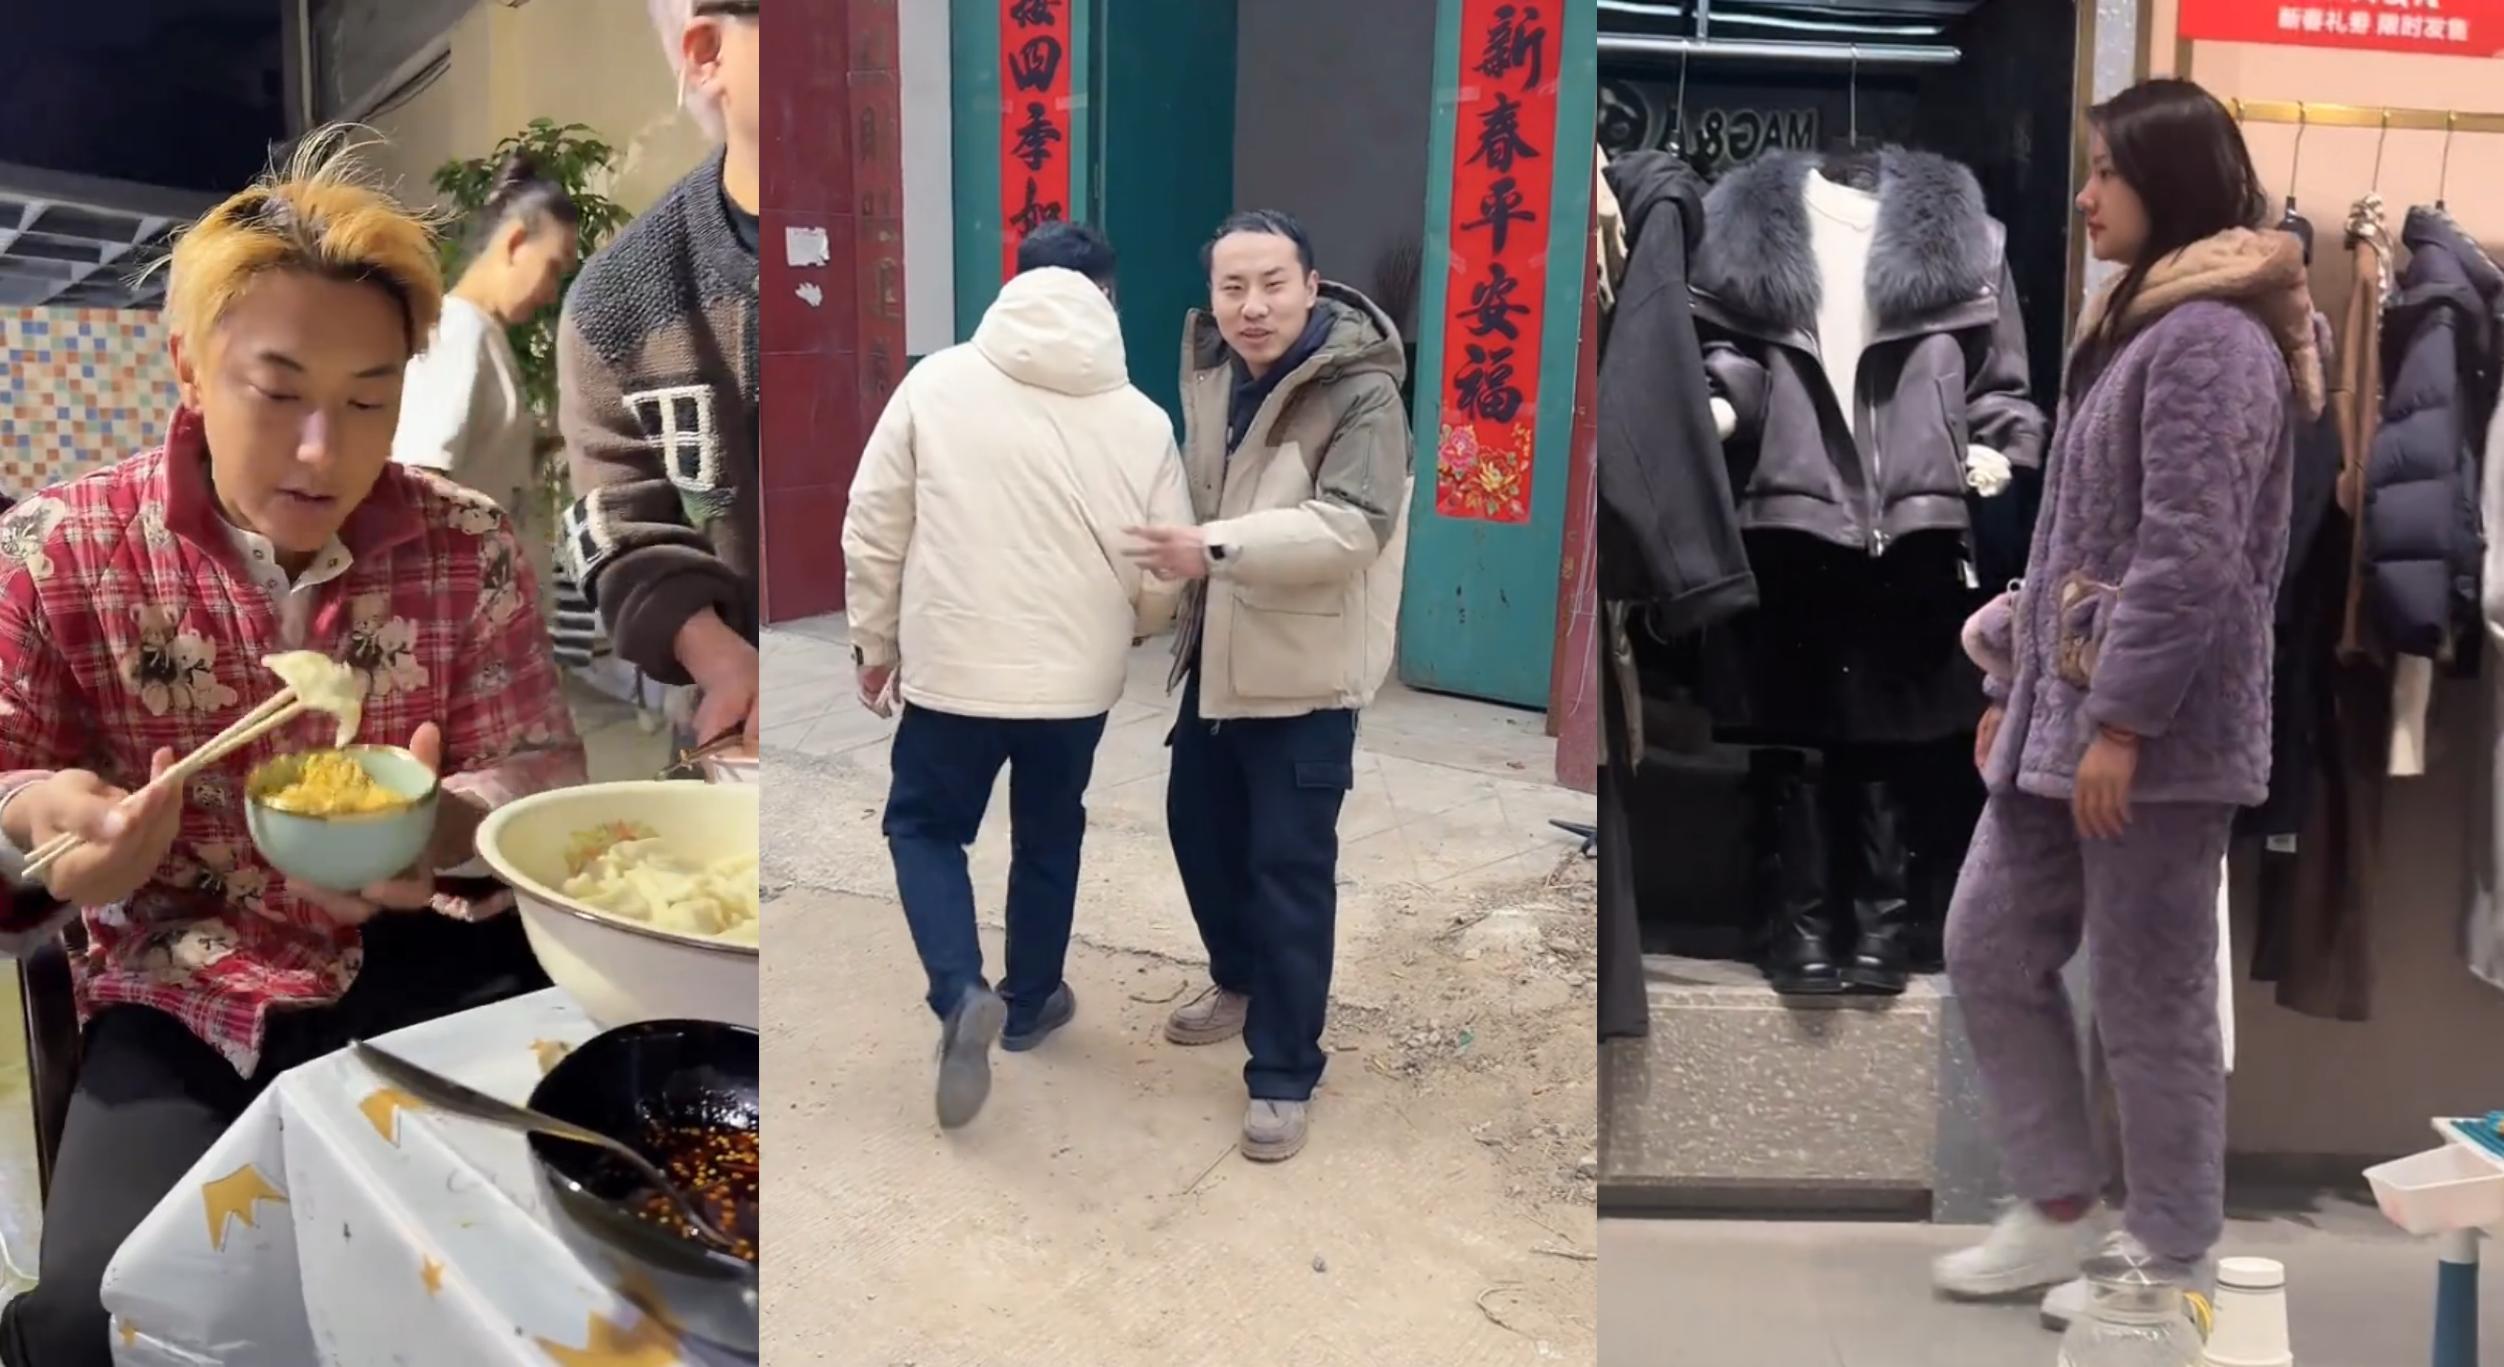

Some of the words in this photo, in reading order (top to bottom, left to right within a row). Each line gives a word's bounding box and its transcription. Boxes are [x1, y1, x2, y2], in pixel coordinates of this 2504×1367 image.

[1455, 6, 1547, 425] 新春平安福
